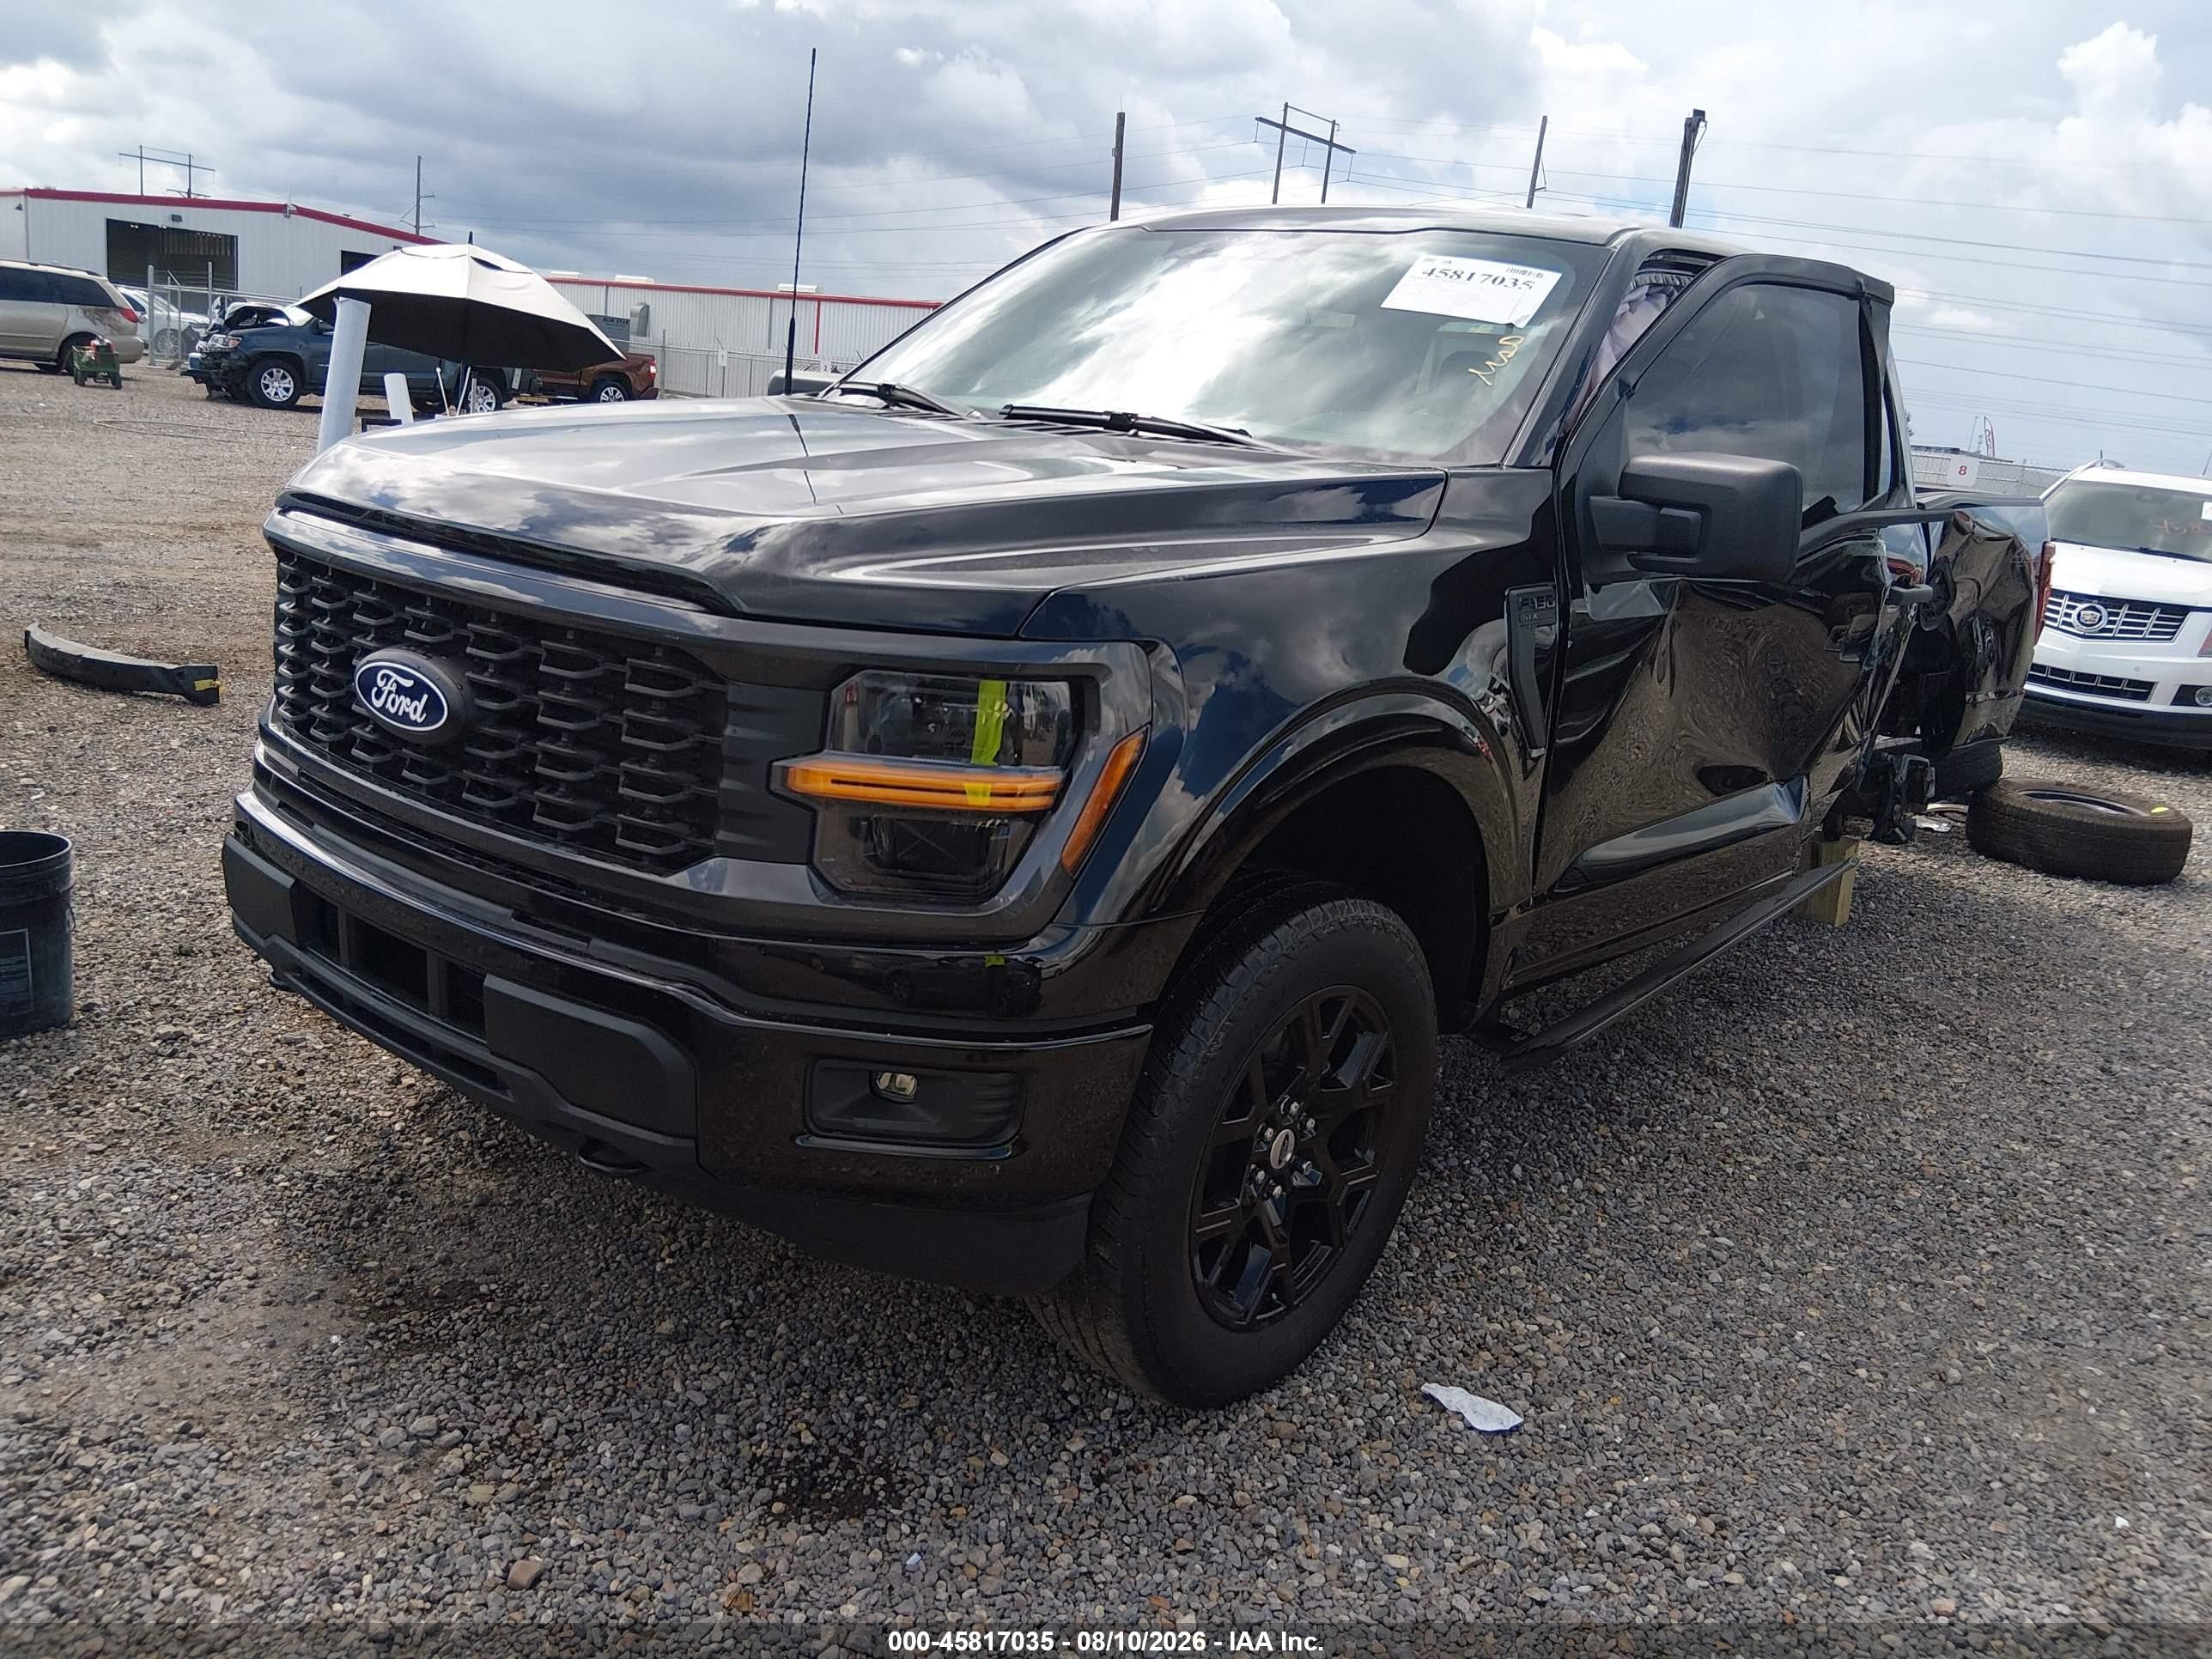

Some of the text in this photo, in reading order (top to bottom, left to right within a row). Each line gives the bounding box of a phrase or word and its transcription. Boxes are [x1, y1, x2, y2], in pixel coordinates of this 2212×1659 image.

[1422, 267, 1535, 290] 45817035
[1958, 465, 1967, 476] 8
[371, 668, 429, 724] Ford
